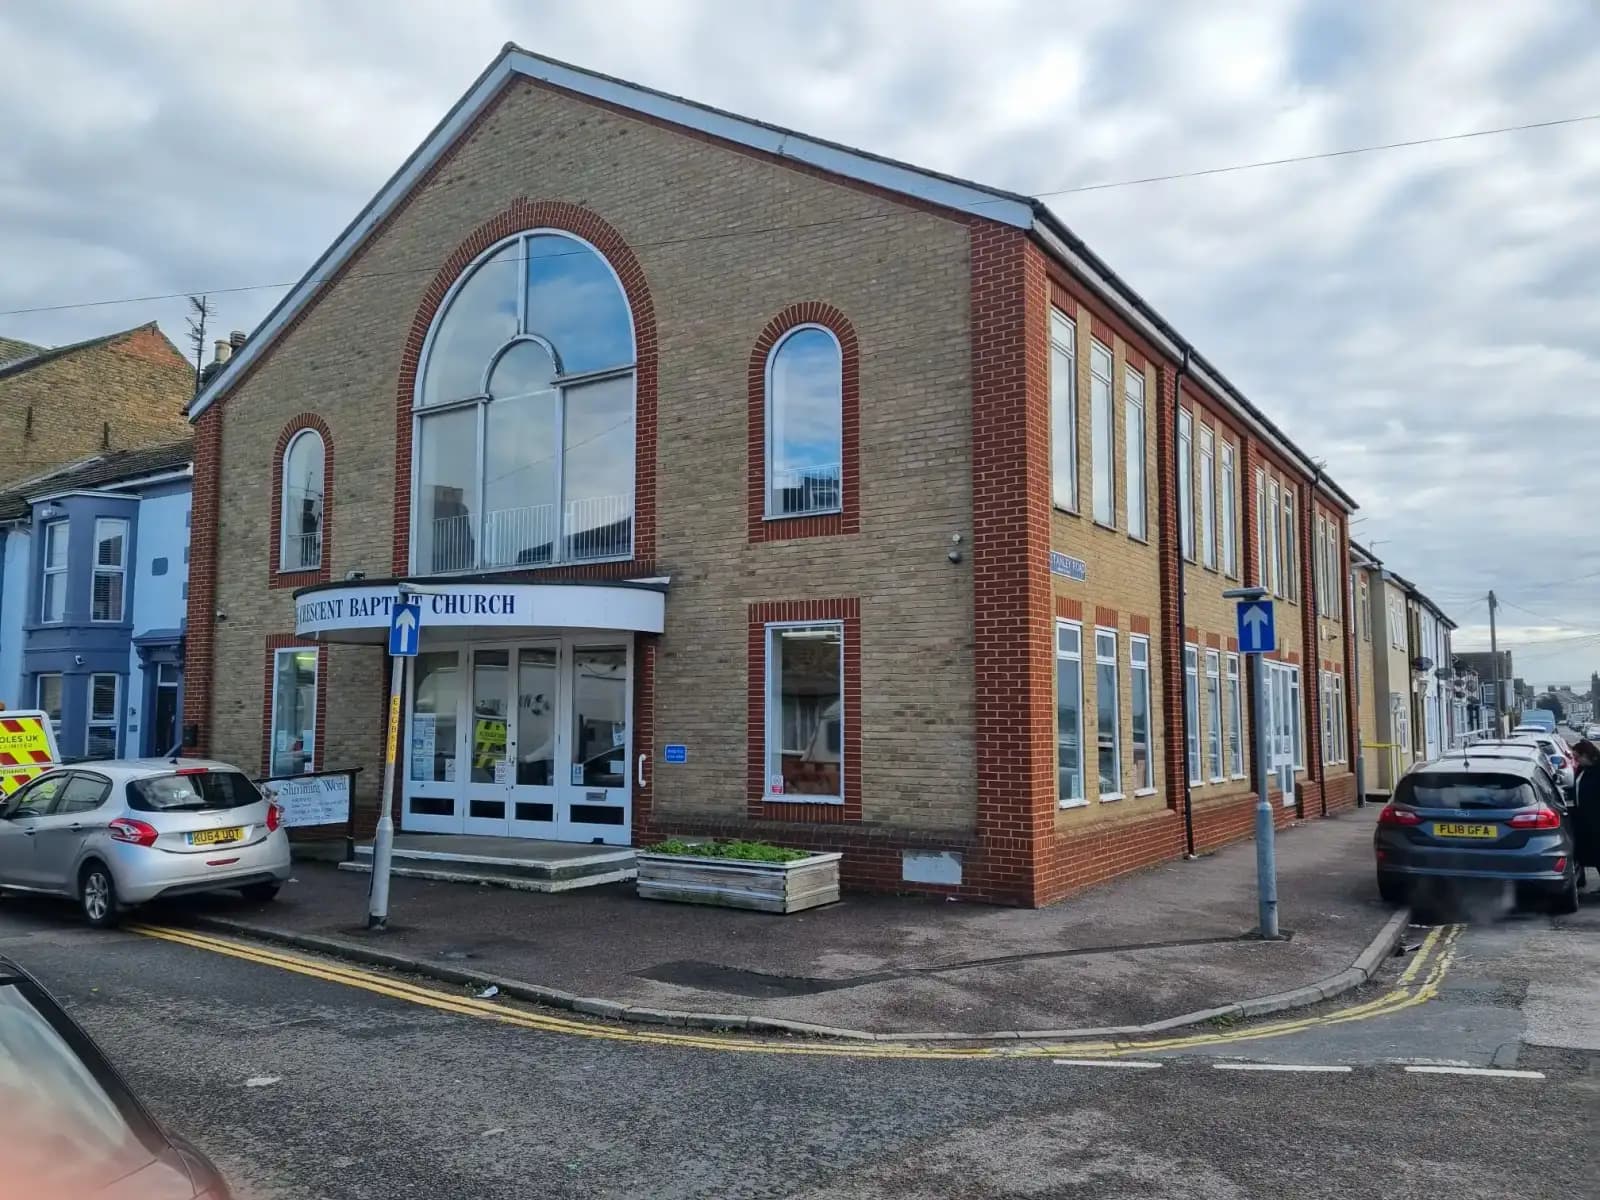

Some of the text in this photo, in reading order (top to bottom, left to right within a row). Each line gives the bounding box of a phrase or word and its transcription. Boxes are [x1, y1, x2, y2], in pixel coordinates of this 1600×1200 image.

[299, 594, 515, 624] CRESCENT BAPT CHURCH
[193, 831, 220, 843] KU64
